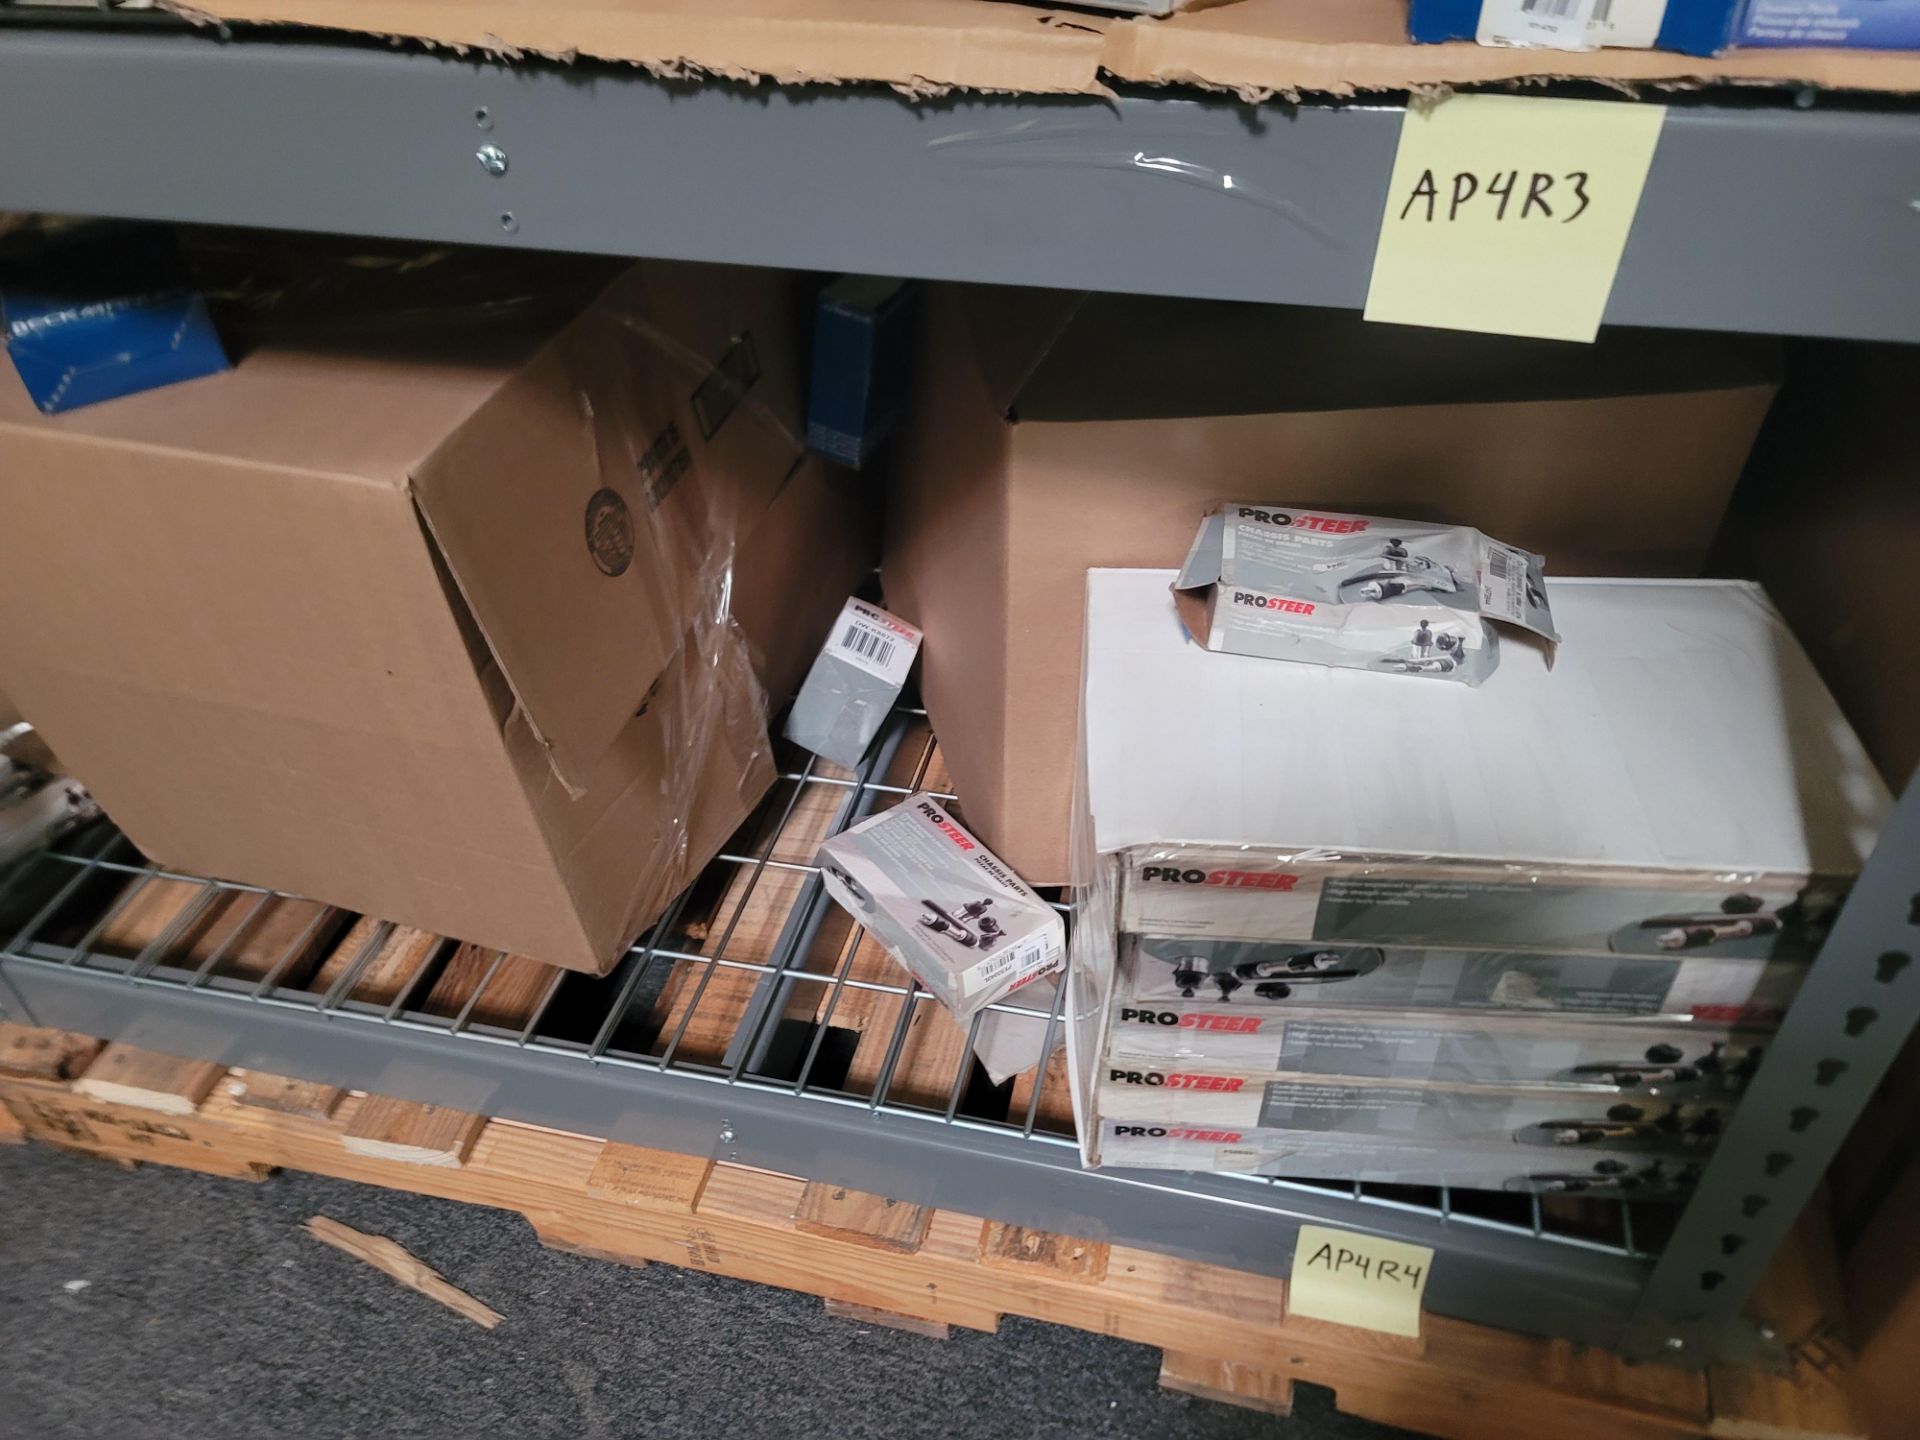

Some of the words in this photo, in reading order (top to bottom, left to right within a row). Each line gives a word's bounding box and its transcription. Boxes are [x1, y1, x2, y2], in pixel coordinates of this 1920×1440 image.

[1399, 168, 1591, 225] AP4R3
[1238, 507, 1371, 534] PROSTEER
[1233, 591, 1316, 616] PROSTEER
[917, 801, 976, 851] PROSTEER
[979, 855, 1007, 878] CHASSIS
[1006, 879, 1028, 897] PARTS
[1142, 866, 1300, 892] PROSTEER
[1121, 1008, 1263, 1034] PROSTEER
[1110, 1069, 1245, 1093] PROSTEER
[1114, 1125, 1243, 1145] PROSTEER
[1306, 1242, 1423, 1290] AP4R4
